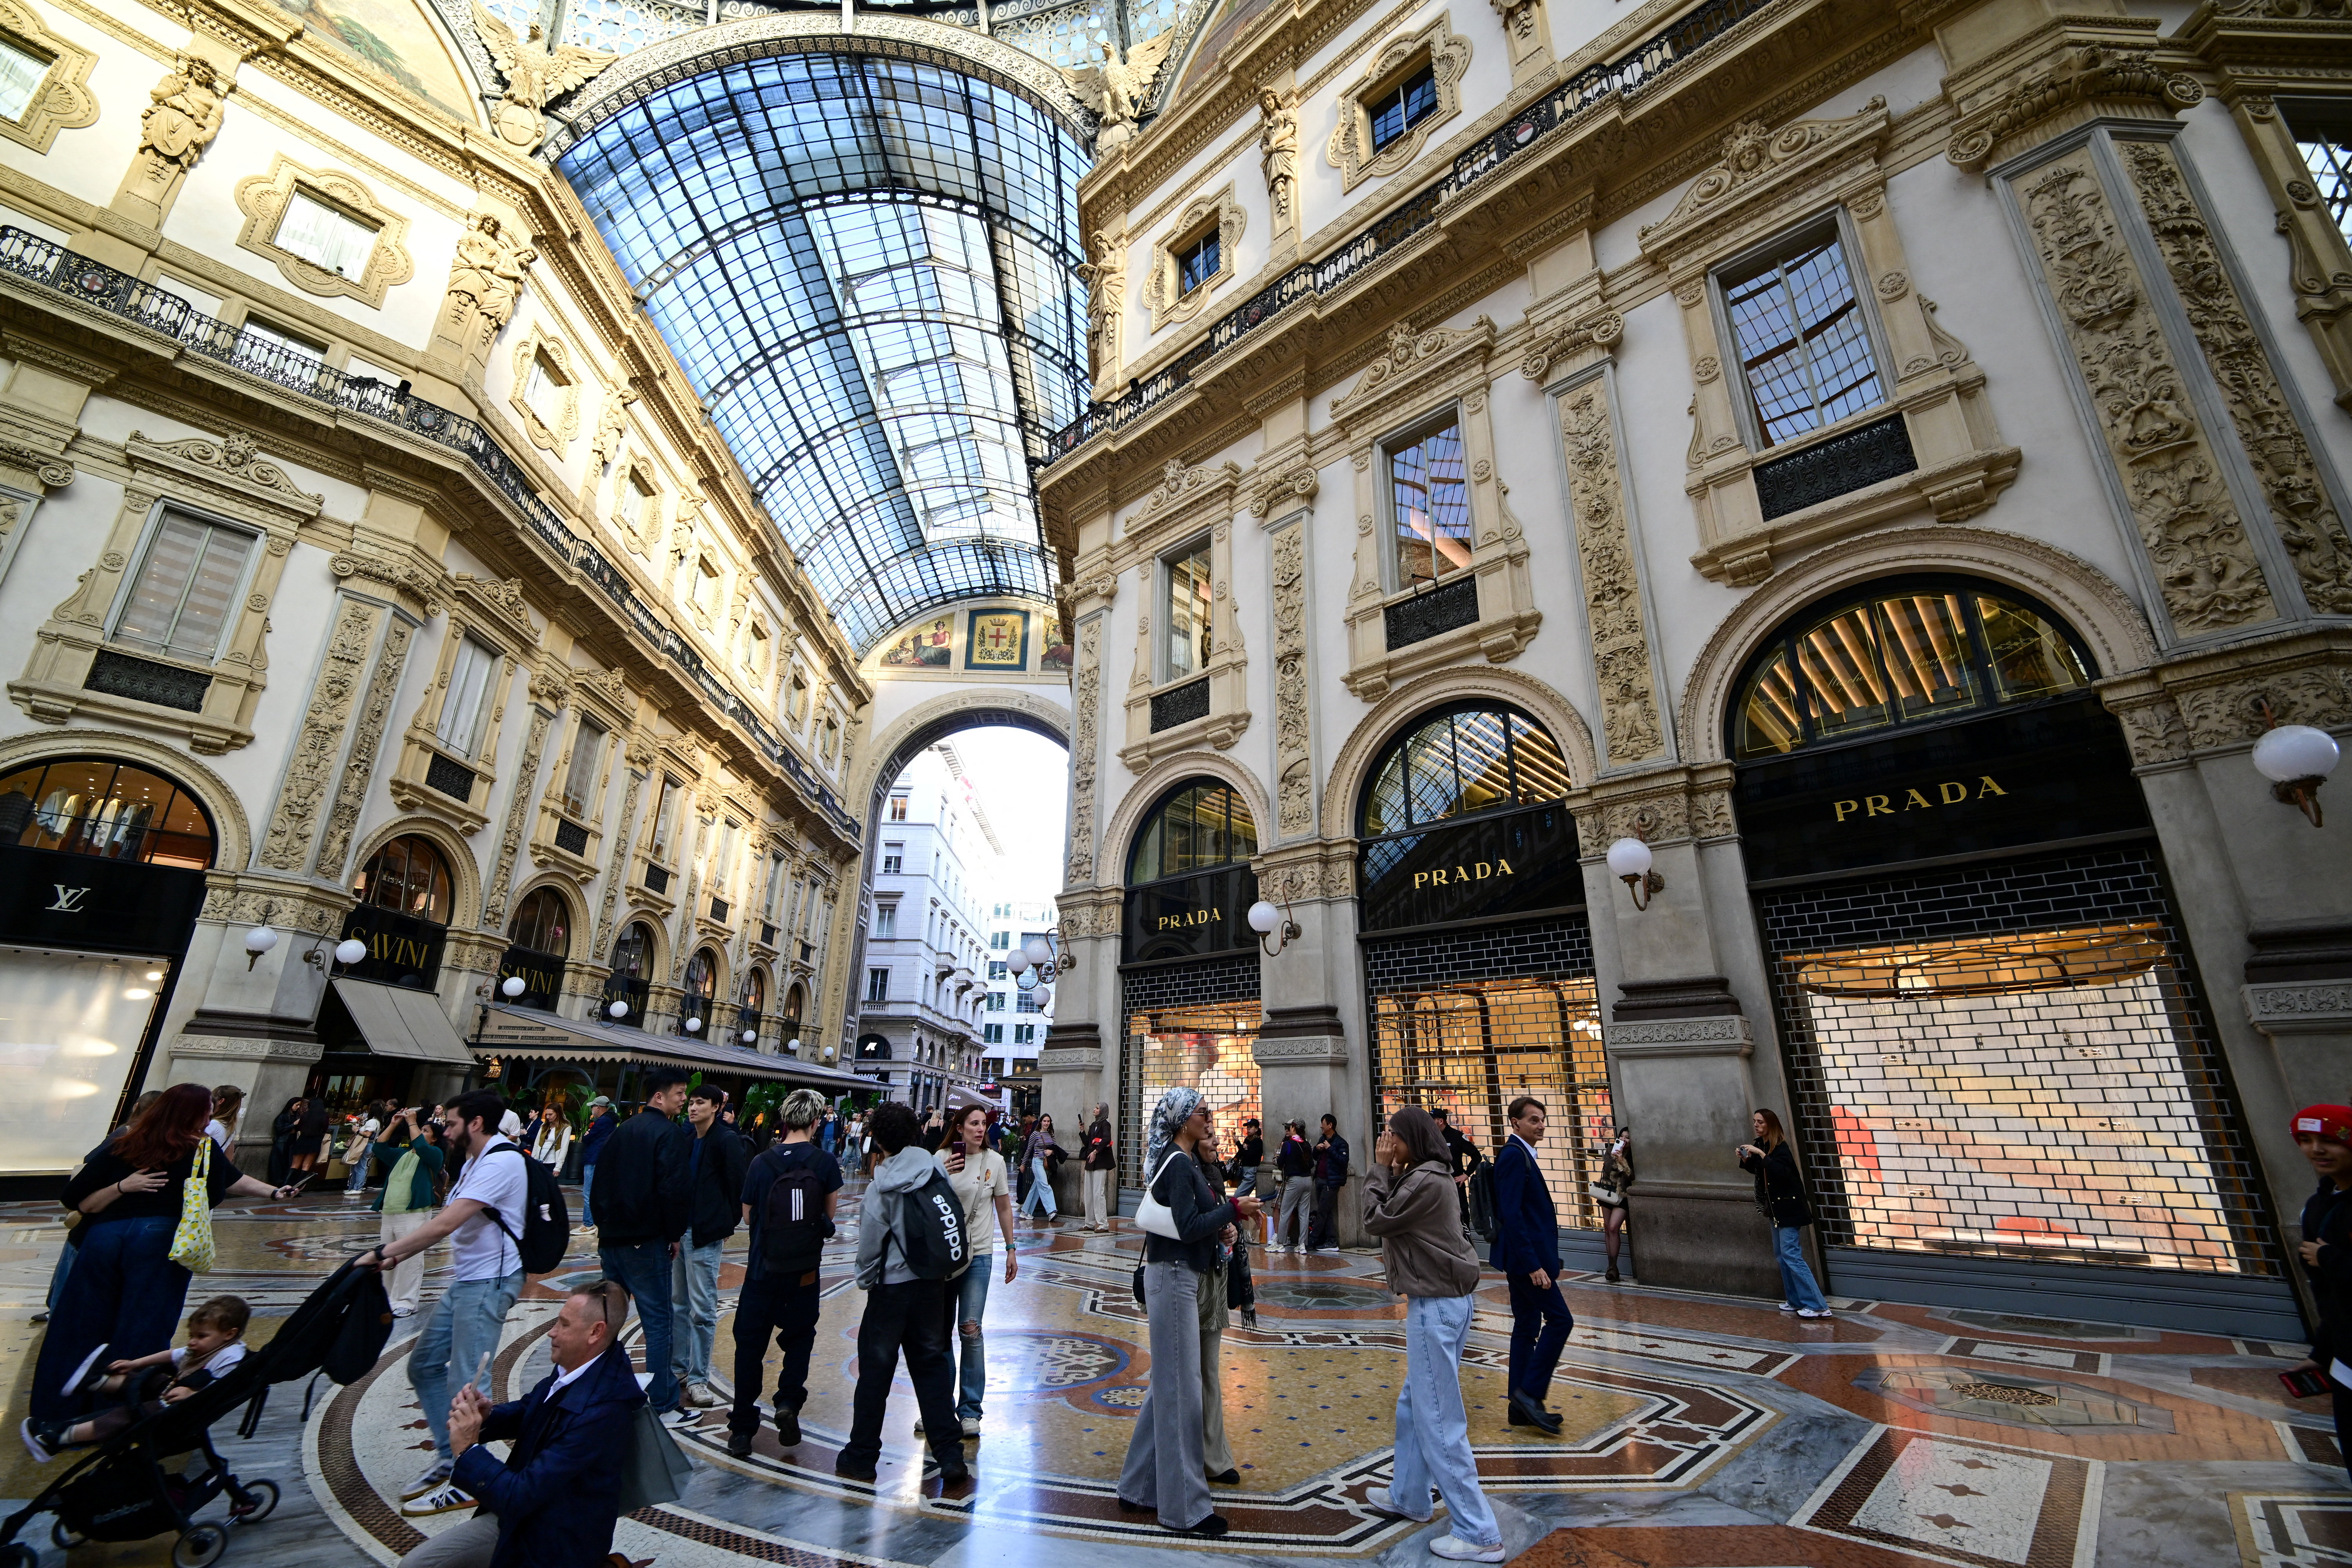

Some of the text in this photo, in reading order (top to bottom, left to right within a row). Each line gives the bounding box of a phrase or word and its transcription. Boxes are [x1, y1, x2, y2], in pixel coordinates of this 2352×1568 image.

[1894, 649, 1958, 672] Marchesi
[1833, 776, 2009, 822] PRADA
[1414, 859, 1514, 889] PRADA
[1159, 907, 1222, 930] PRADA
[350, 927, 429, 969] SAVINI
[498, 963, 554, 995] SAVINI
[601, 987, 641, 1013] SAVINI
[933, 1194, 962, 1261] adidas
